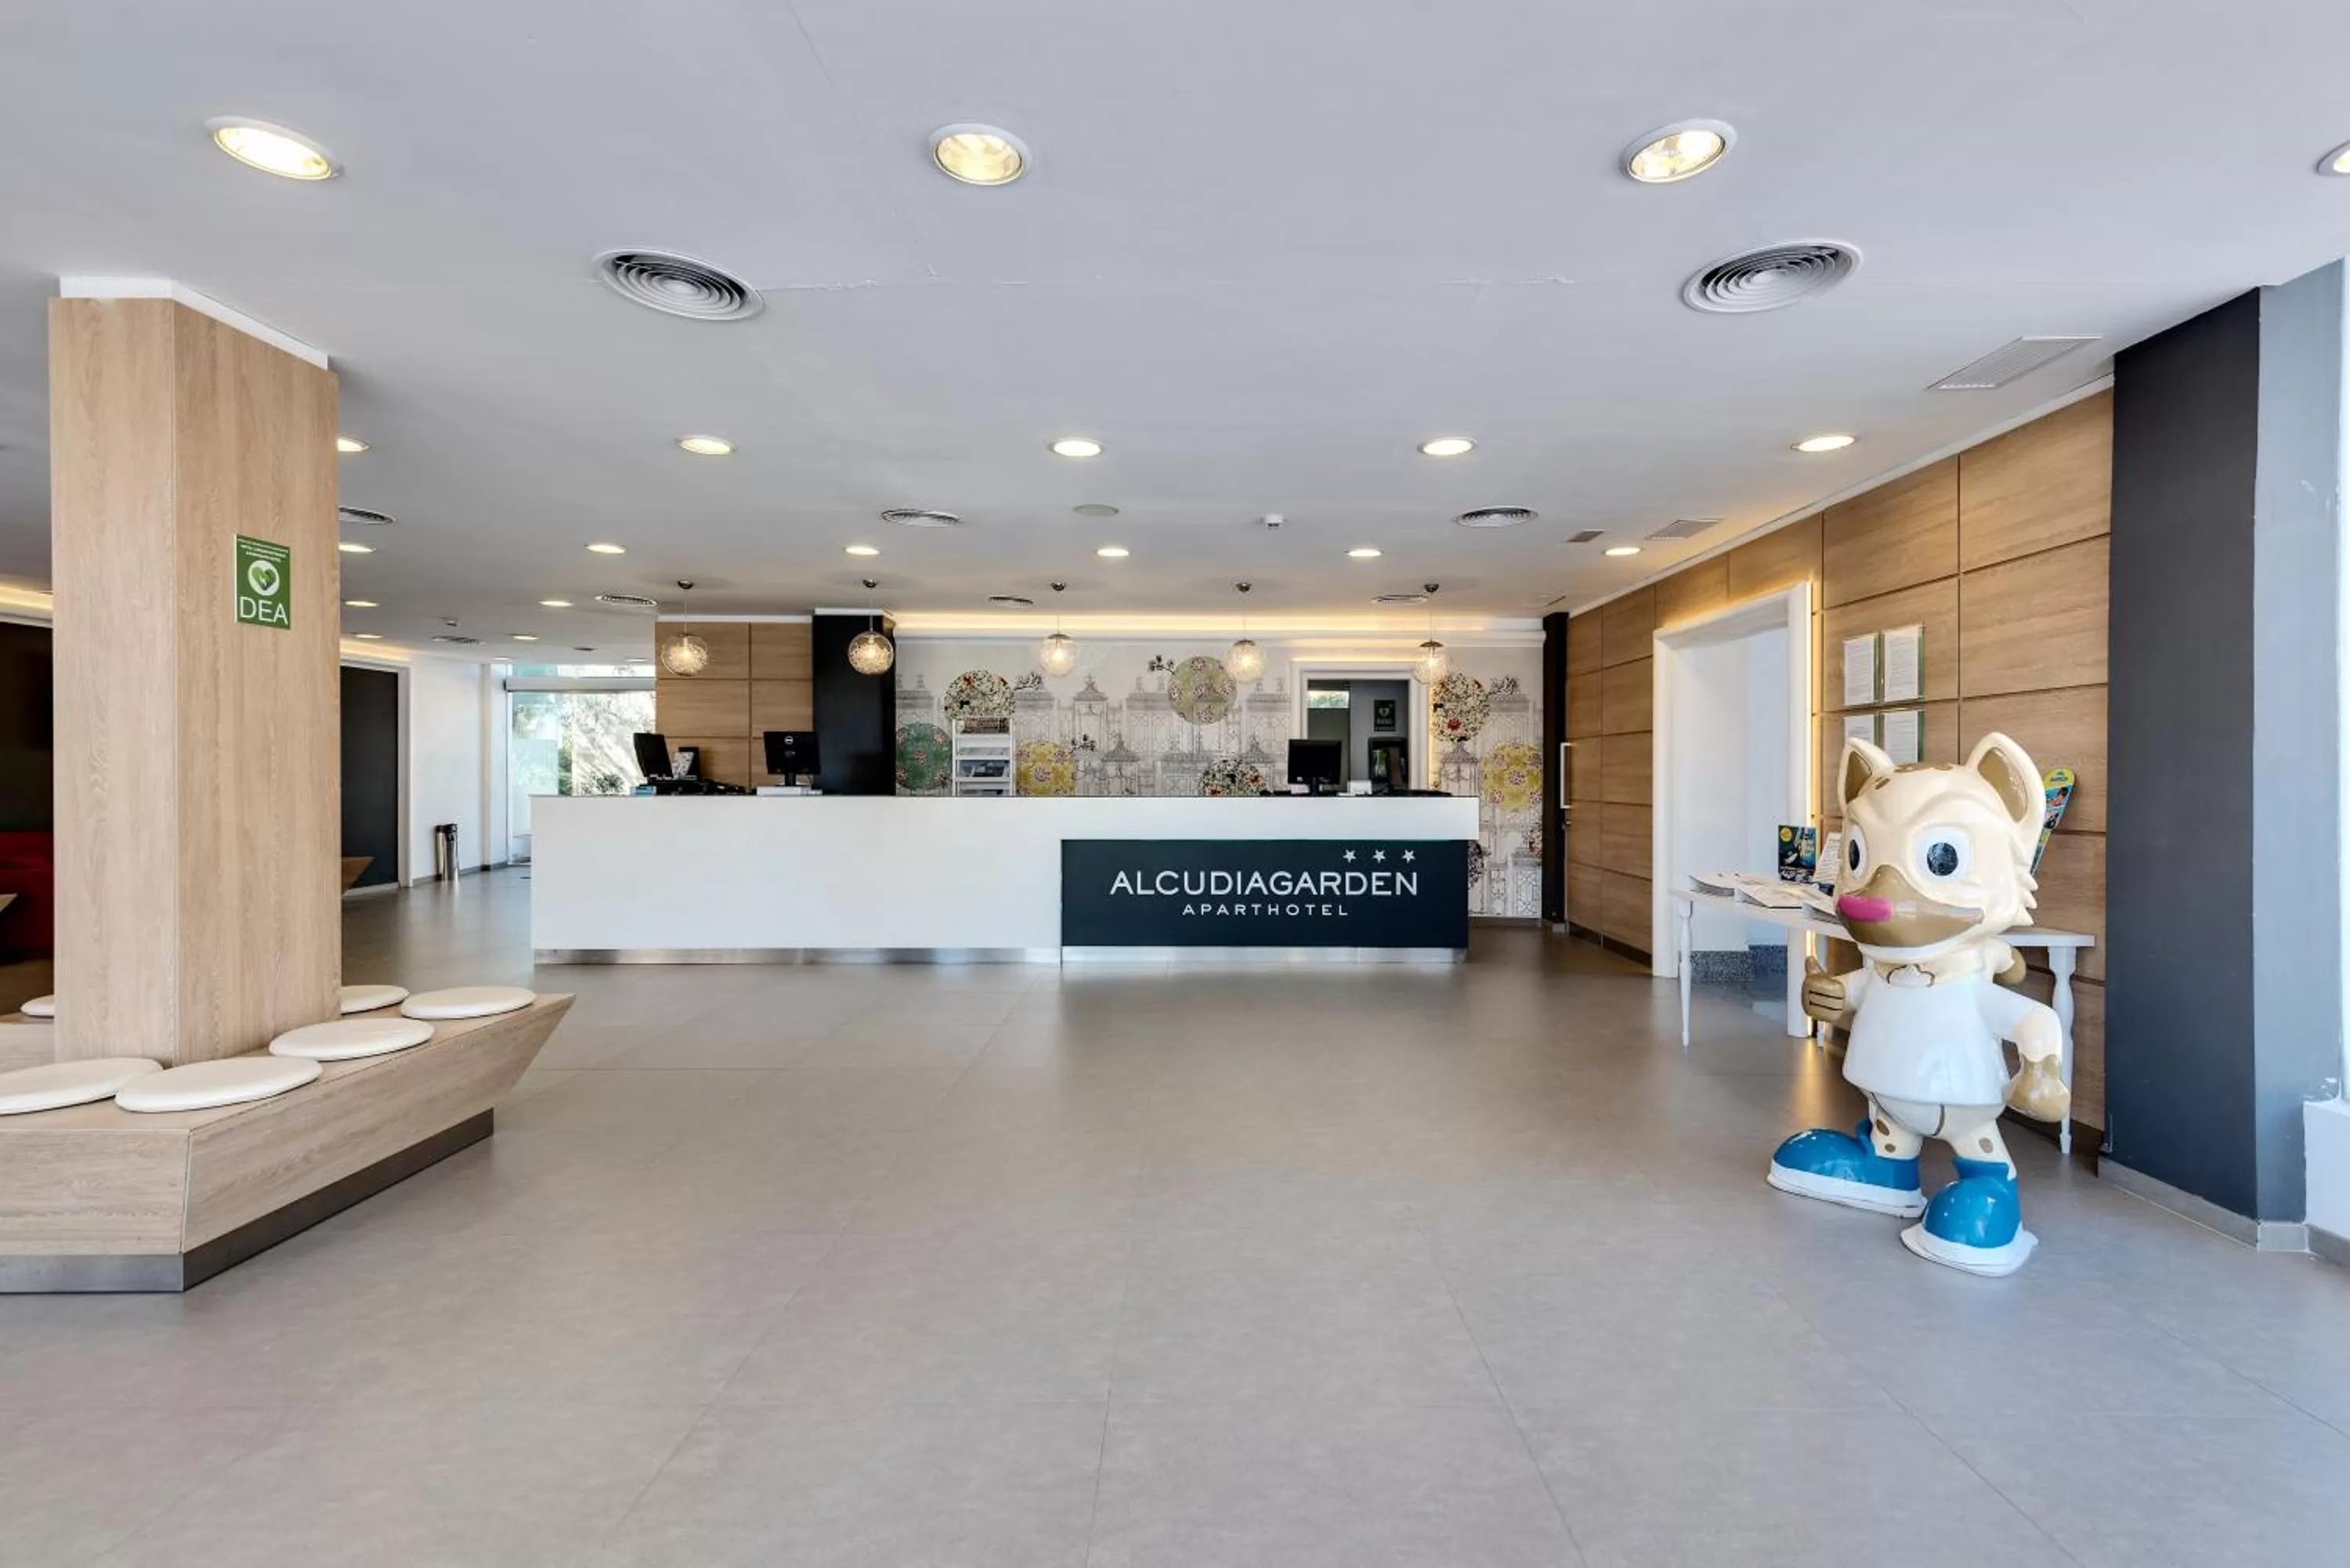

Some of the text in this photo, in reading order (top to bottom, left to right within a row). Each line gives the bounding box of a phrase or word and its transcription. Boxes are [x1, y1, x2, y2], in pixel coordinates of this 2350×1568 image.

[239, 596, 289, 626] DEA
[1109, 870, 1418, 896] ALCUDIAGARDEN
[1182, 903, 1349, 916] APARTHOTEL
